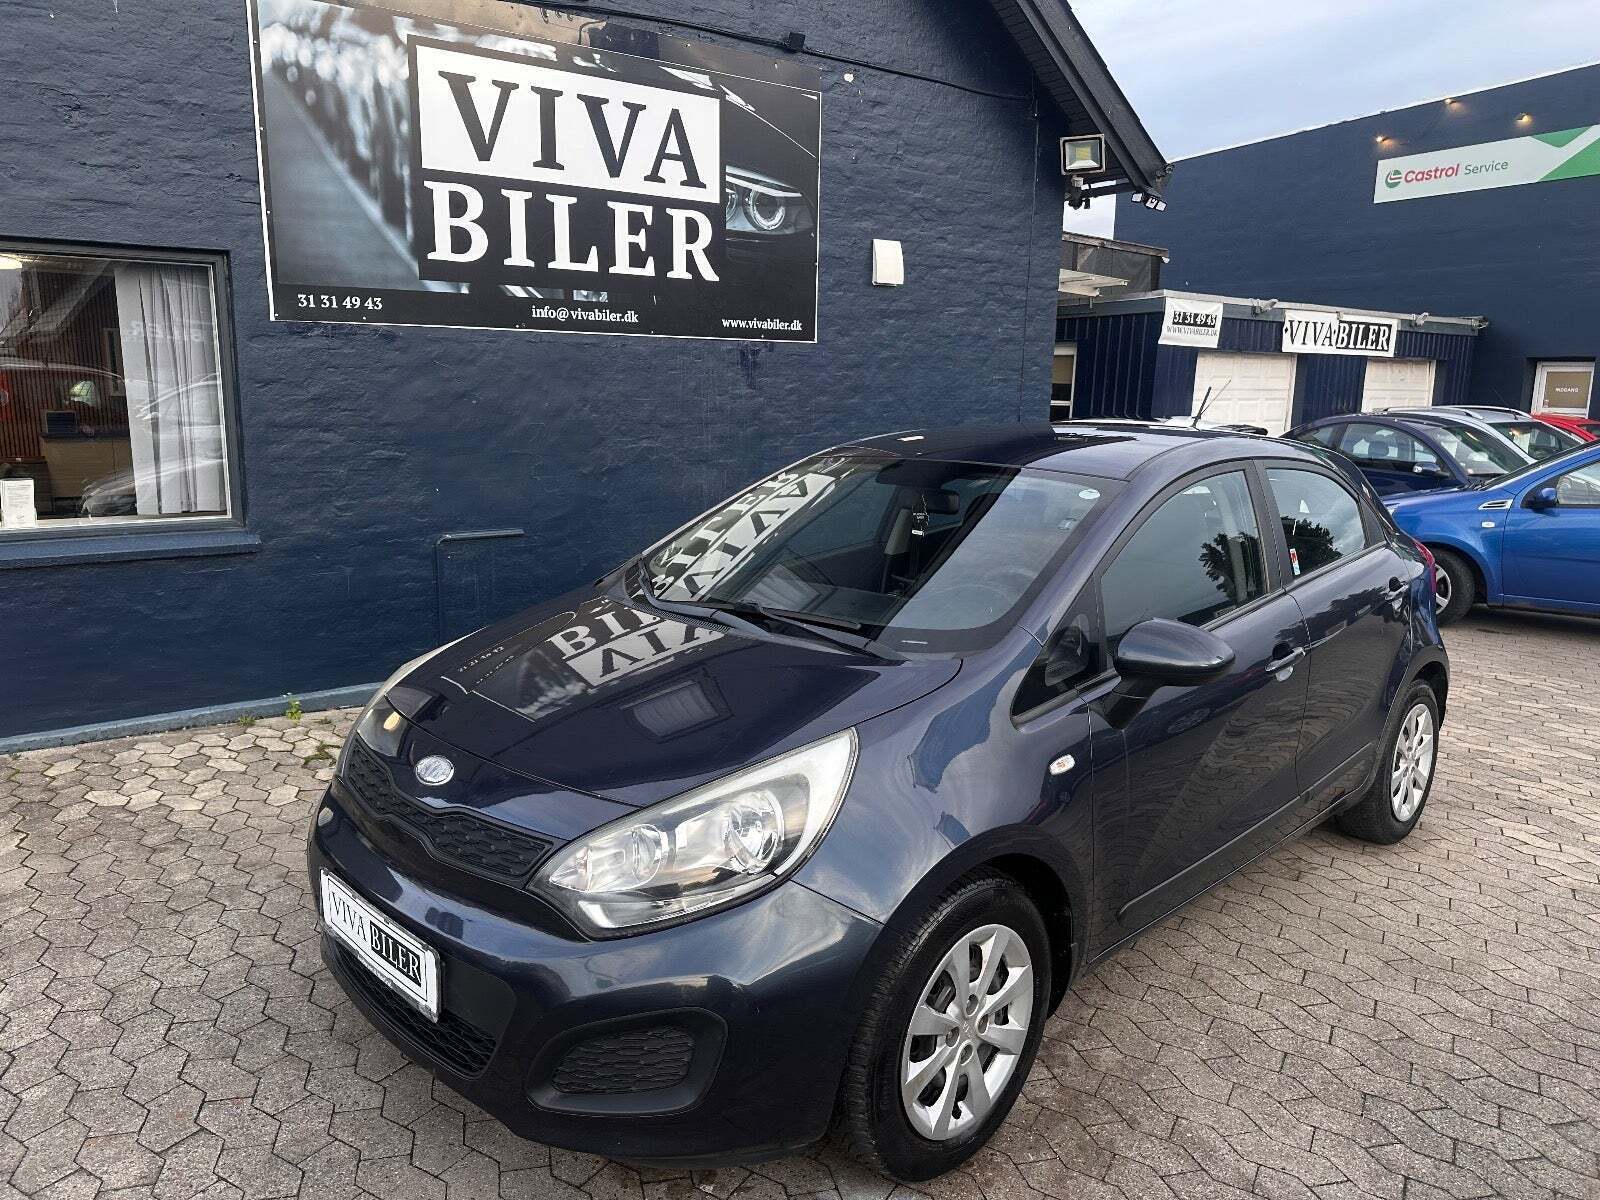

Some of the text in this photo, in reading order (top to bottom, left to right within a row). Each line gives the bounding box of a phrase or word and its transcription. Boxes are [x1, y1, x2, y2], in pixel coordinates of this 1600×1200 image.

[438, 70, 707, 189] VIVA
[1403, 160, 1509, 183] Castrol Service
[423, 181, 720, 282] BILER
[298, 294, 383, 310] 31 31 49 43
[722, 317, 802, 331] www.vivabiler.dk
[1173, 311, 1184, 323] 31
[1288, 320, 1389, 350] VIVA BILER
[331, 890, 368, 942] VIVA
[370, 922, 422, 984] BILER
